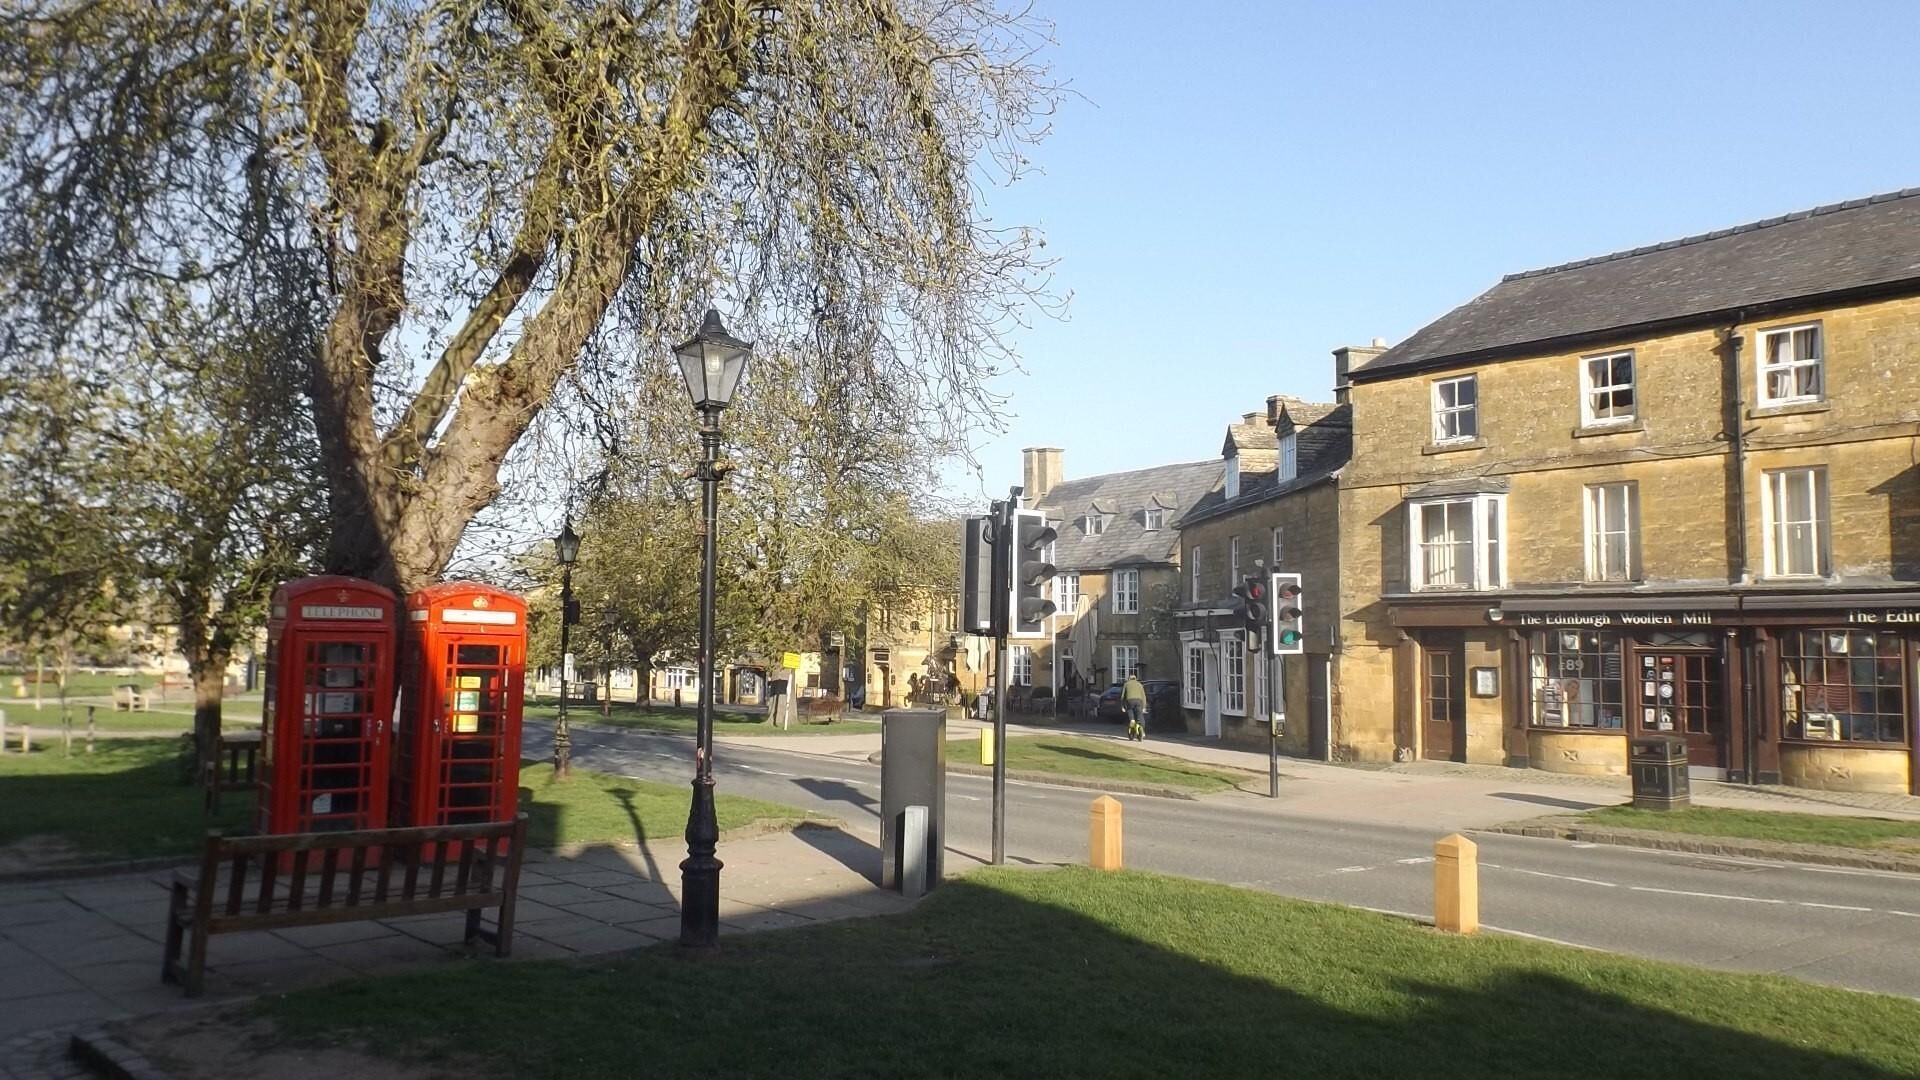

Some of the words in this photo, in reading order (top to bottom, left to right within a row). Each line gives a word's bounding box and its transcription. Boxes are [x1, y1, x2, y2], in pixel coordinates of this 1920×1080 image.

[305, 607, 379, 617] TELEPHONE
[1848, 610, 1878, 623] The
[1520, 613, 1542, 625] The
[1545, 612, 1611, 628] Edinburgh
[1620, 611, 1673, 625] Woollen
[1682, 611, 1712, 625] Mill
